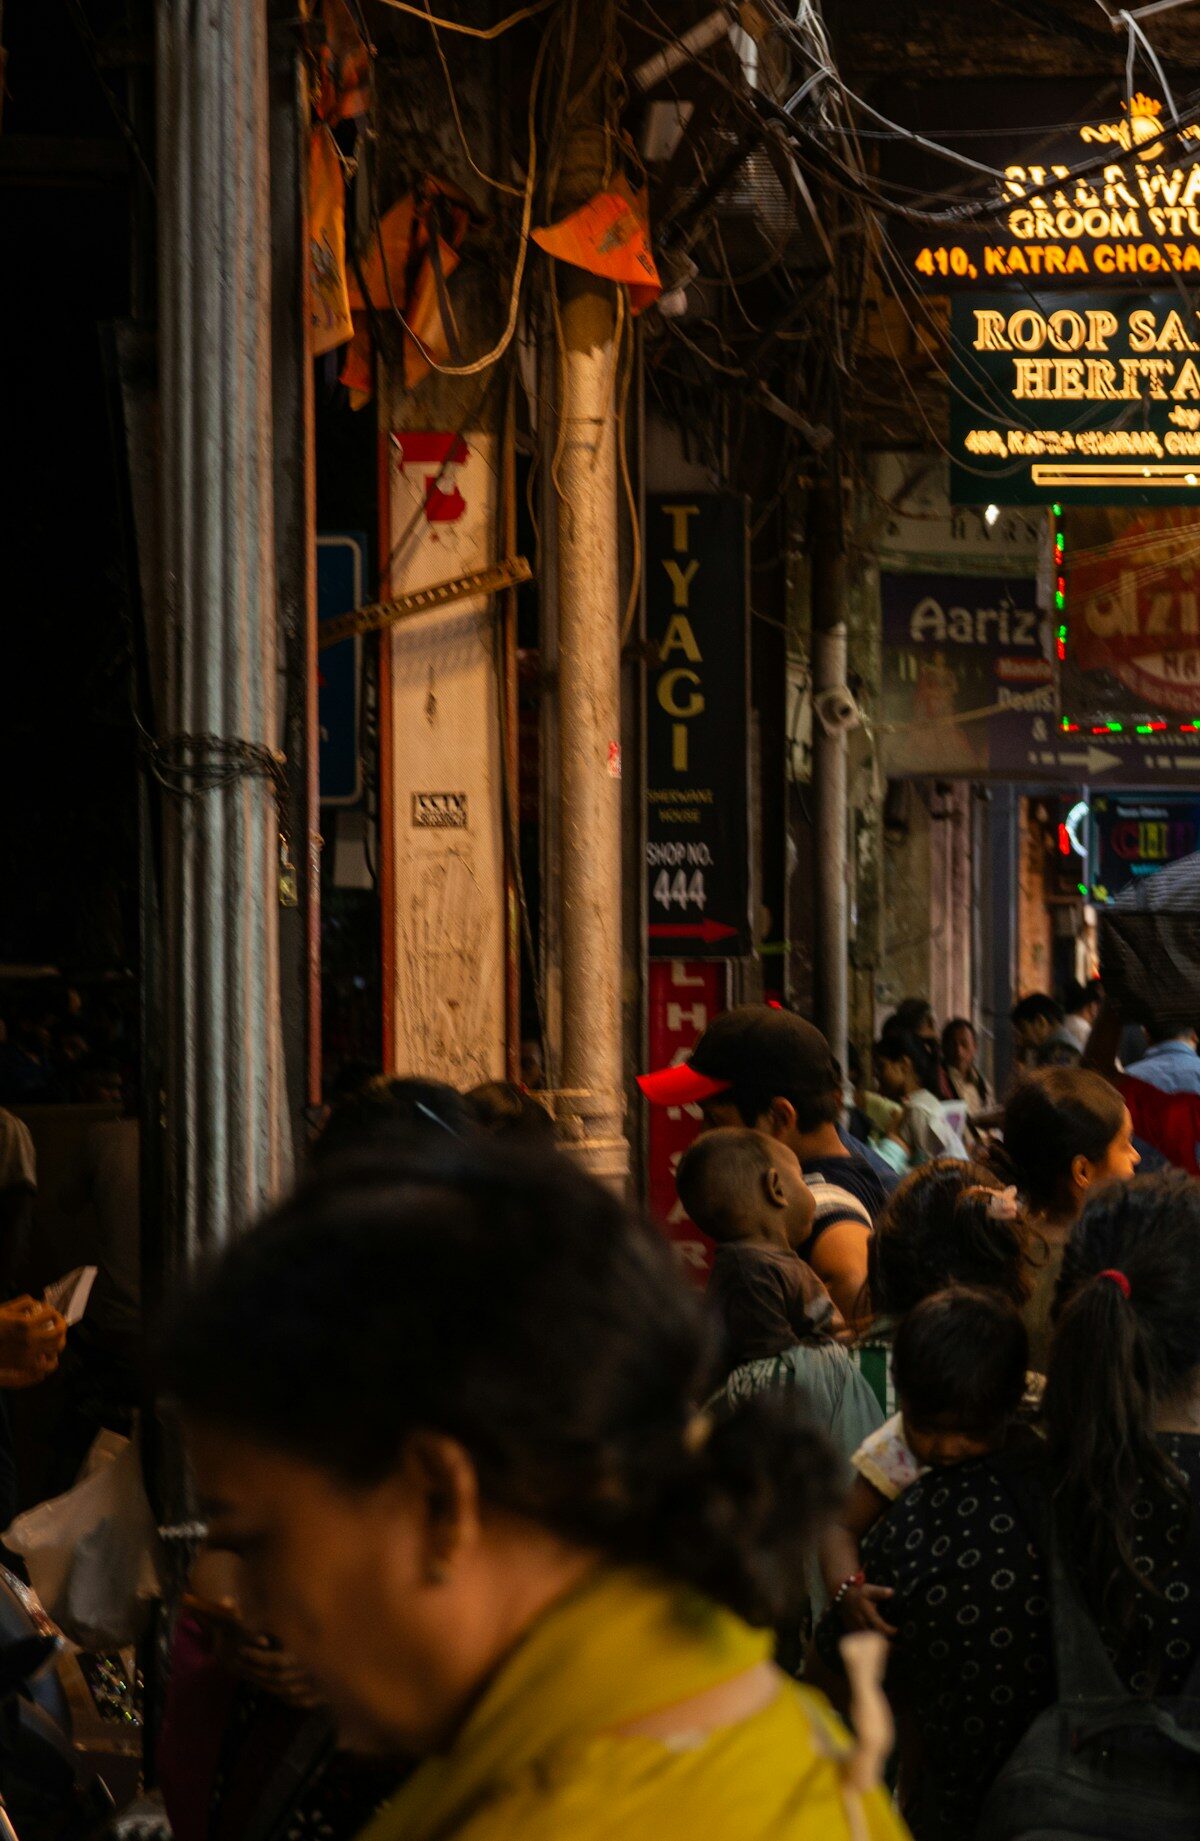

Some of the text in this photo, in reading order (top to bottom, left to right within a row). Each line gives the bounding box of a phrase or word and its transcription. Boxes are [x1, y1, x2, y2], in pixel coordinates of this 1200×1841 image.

[1008, 207, 1142, 239] GROOM
[914, 246, 978, 279] 410,
[984, 245, 1089, 274] KATRA
[972, 310, 1119, 351] ROOP
[655, 503, 706, 773] TYAGI
[647, 841, 715, 866] SHOP NO.
[652, 867, 707, 912] 444
